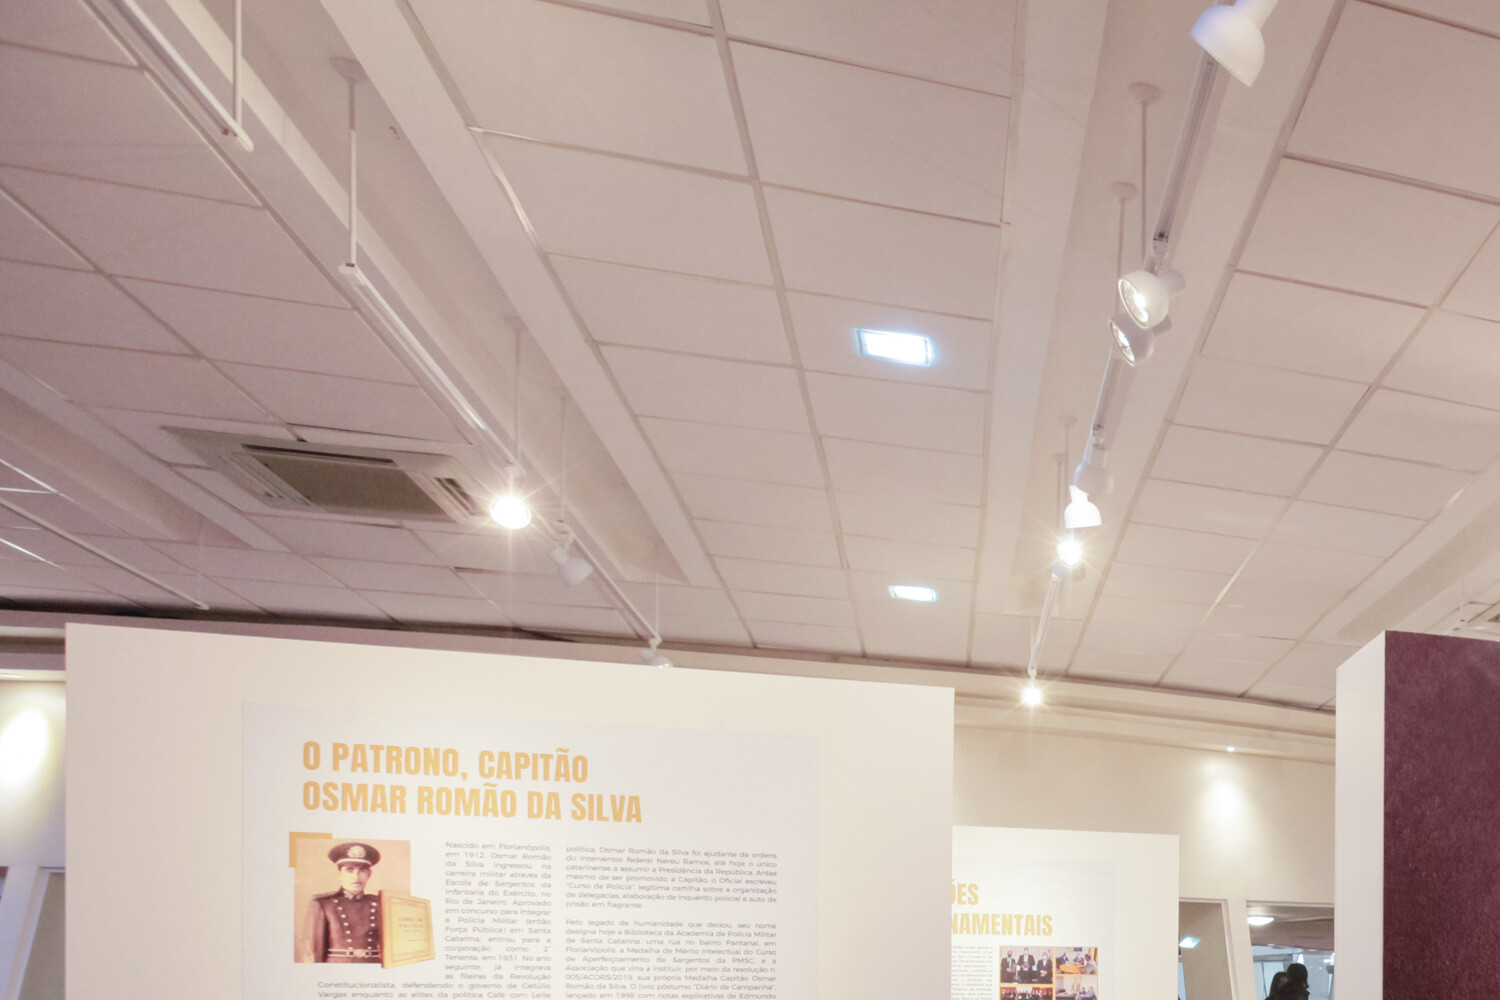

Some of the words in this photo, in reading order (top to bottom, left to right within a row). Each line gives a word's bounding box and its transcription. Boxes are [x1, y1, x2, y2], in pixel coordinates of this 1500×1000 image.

[303, 741, 320, 770] O
[332, 742, 468, 781] PATRONO,
[478, 748, 588, 783] CAPITÃO
[303, 781, 406, 814] OSMAR
[417, 782, 516, 818] ROMÃO
[527, 791, 561, 820] DA
[571, 793, 642, 823] SILVA
